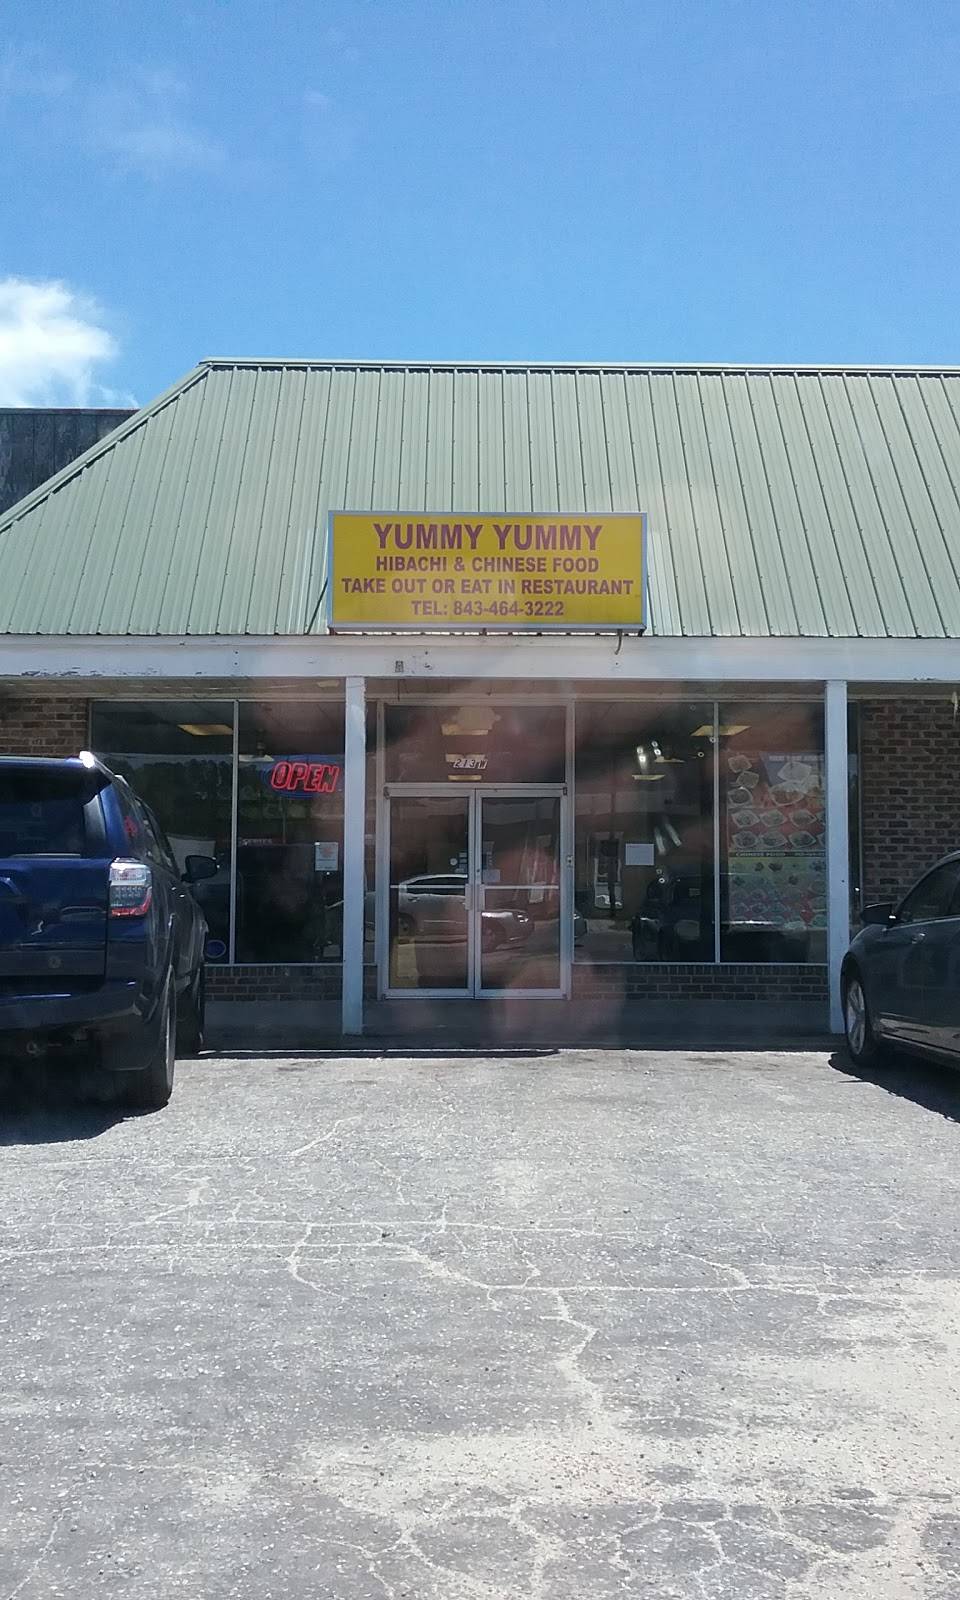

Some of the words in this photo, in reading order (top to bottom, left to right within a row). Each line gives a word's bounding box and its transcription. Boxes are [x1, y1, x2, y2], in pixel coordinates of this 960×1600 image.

[373, 523, 483, 550] YUMMY
[493, 524, 602, 550] YUMMY
[376, 556, 447, 572] HIBACHI
[454, 557, 465, 572] &
[471, 556, 546, 573] CHINESE
[553, 557, 599, 573] FOOD
[342, 577, 386, 594] TAKE
[391, 578, 427, 594] OUT
[432, 578, 455, 594] OR
[461, 578, 493, 594] EAT
[499, 579, 516, 594] IN
[521, 579, 634, 595] RESTAURANT
[411, 600, 448, 616] TEL:
[453, 601, 564, 617] 843-464-3222
[271, 762, 340, 792] OPEN
